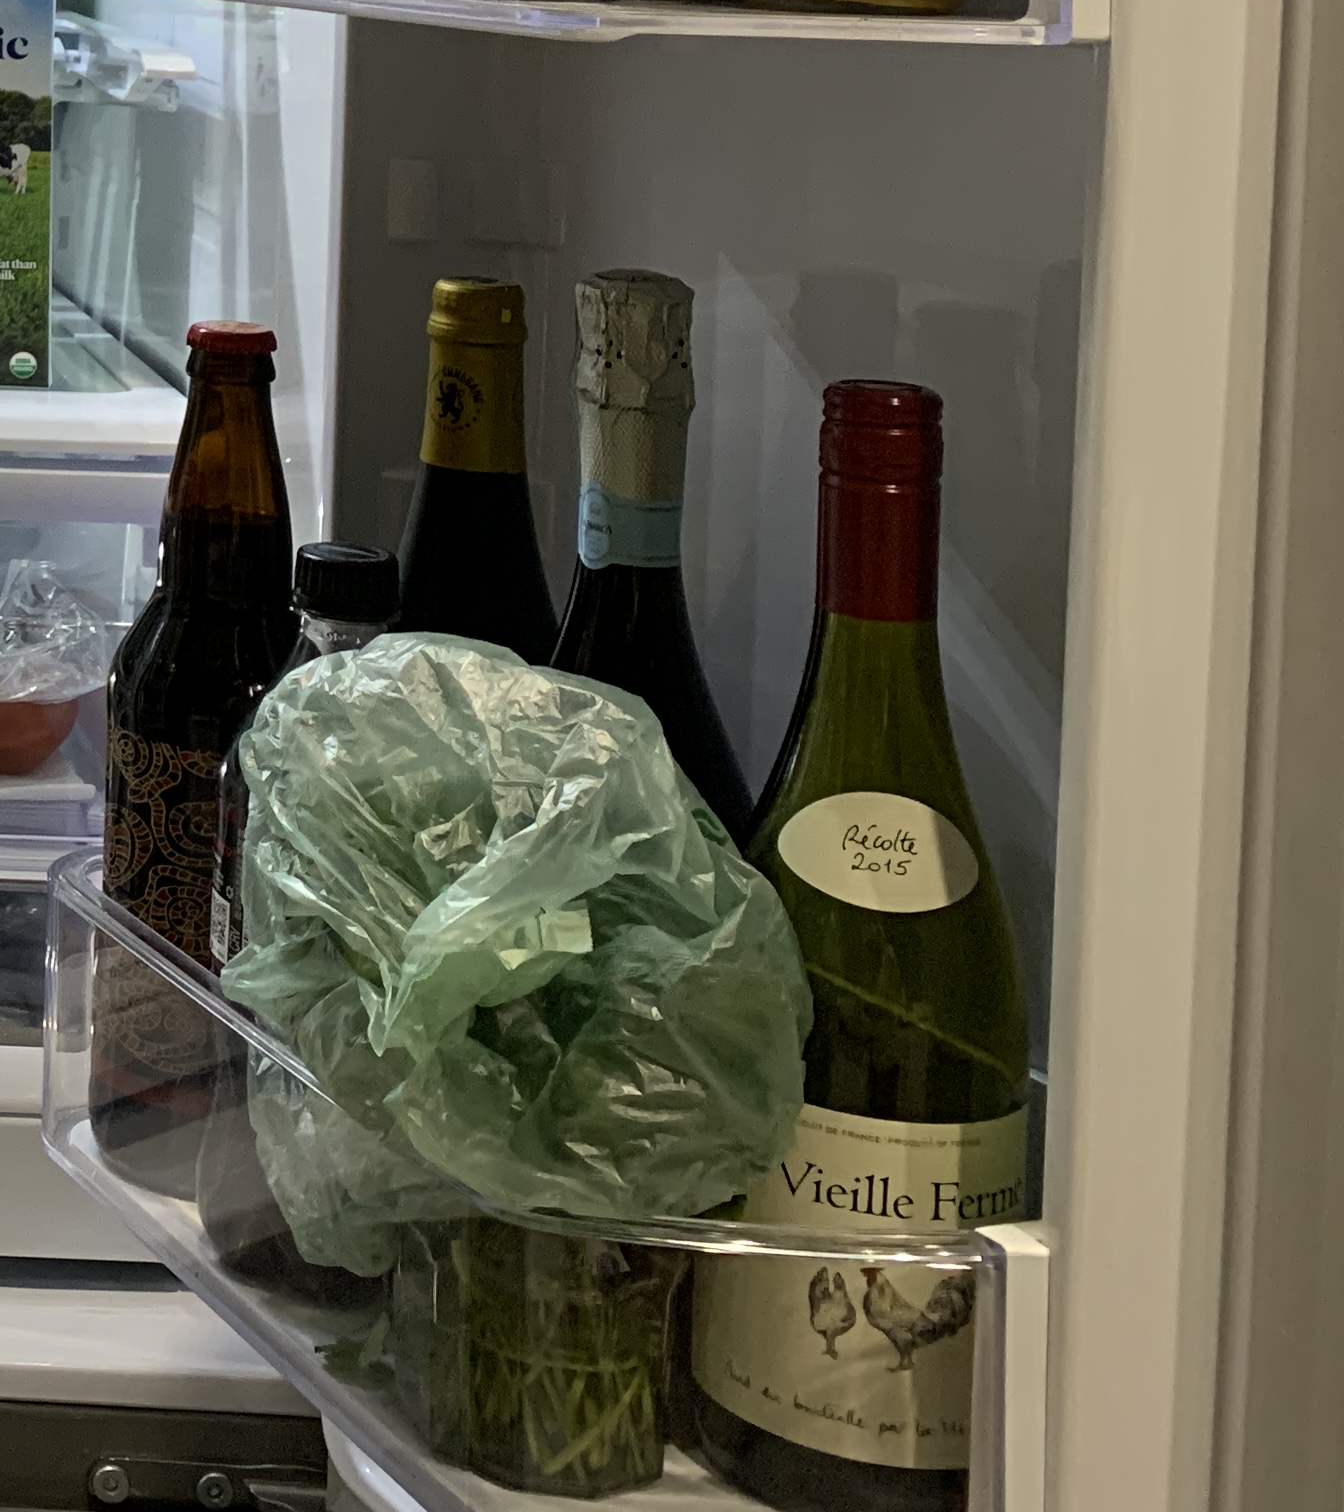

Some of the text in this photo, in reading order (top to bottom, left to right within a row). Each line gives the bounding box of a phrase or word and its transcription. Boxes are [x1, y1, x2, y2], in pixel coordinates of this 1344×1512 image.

[11, 259, 37, 270] than
[841, 825, 920, 856] Récolte
[851, 854, 910, 878] 2015
[825, 1126, 881, 1144] DE FRANCE
[780, 1160, 915, 1219] Vieille
[792, 1389, 906, 1440] bouteille par
